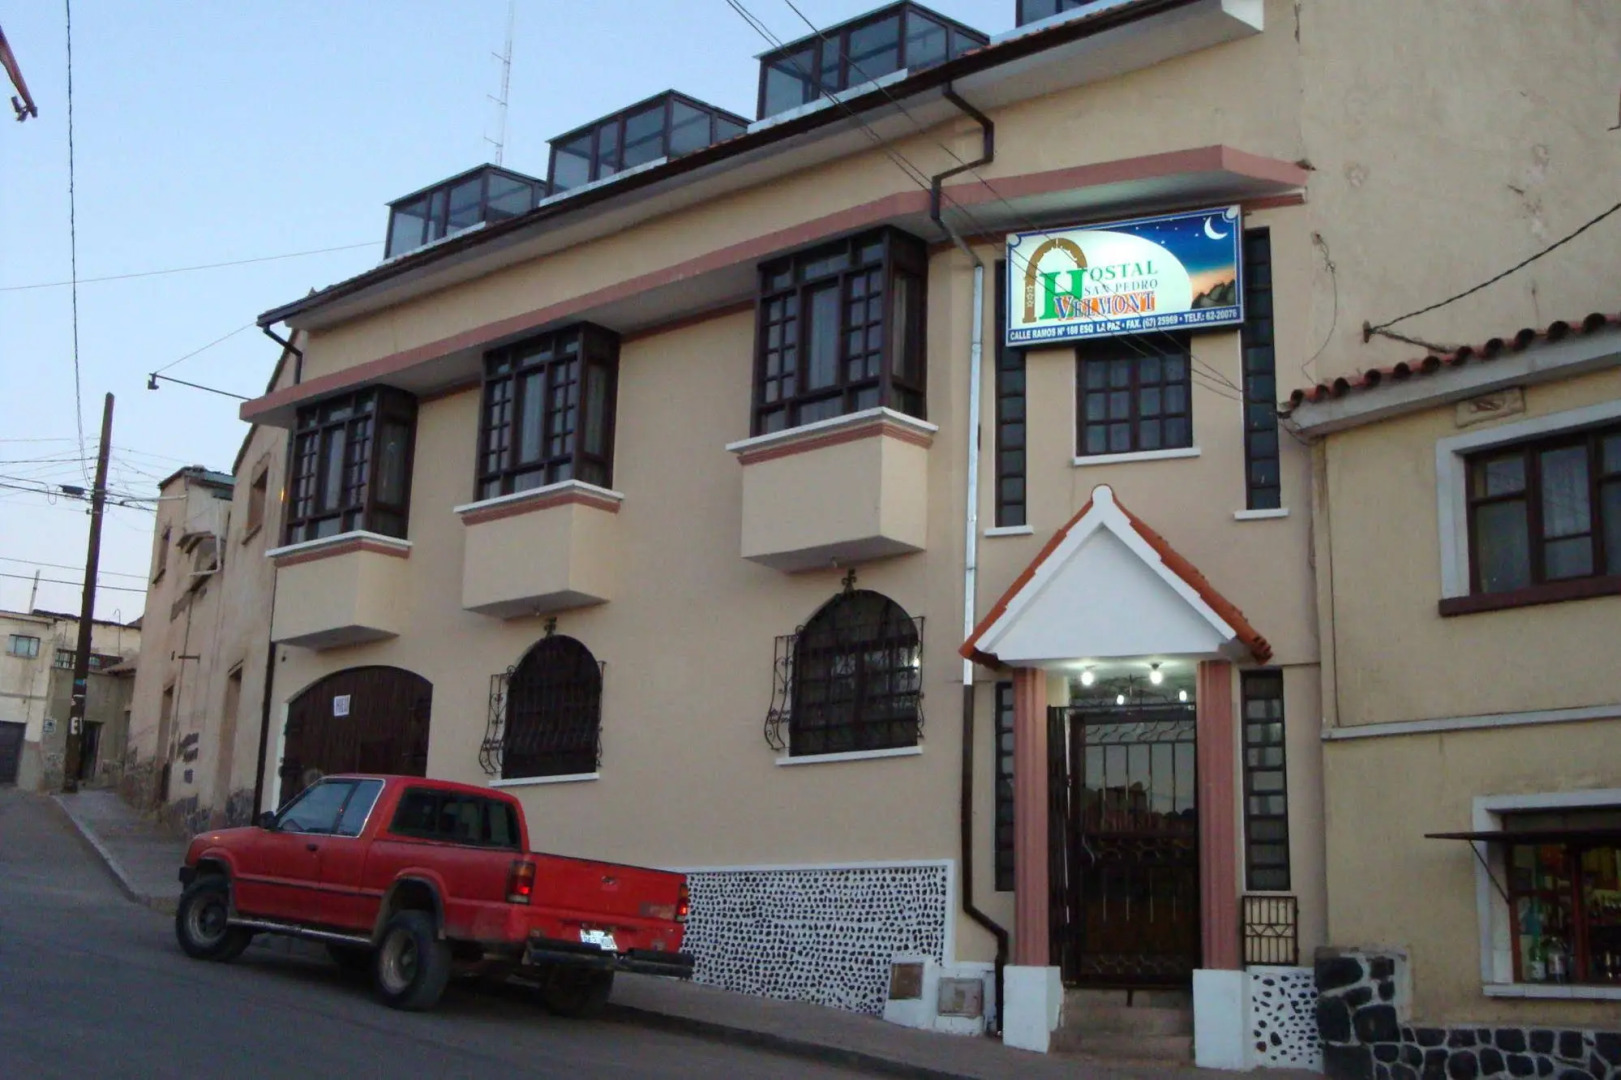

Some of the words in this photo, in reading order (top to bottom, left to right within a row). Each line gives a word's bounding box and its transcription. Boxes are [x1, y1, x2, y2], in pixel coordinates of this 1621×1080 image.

[1085, 284, 1109, 297] SAN
[1115, 279, 1158, 293] PEDRO
[1010, 331, 1031, 340] CALLE
[1032, 328, 1056, 338] RAMOS
[1096, 322, 1106, 332] LA
[1107, 320, 1121, 331] PAZ
